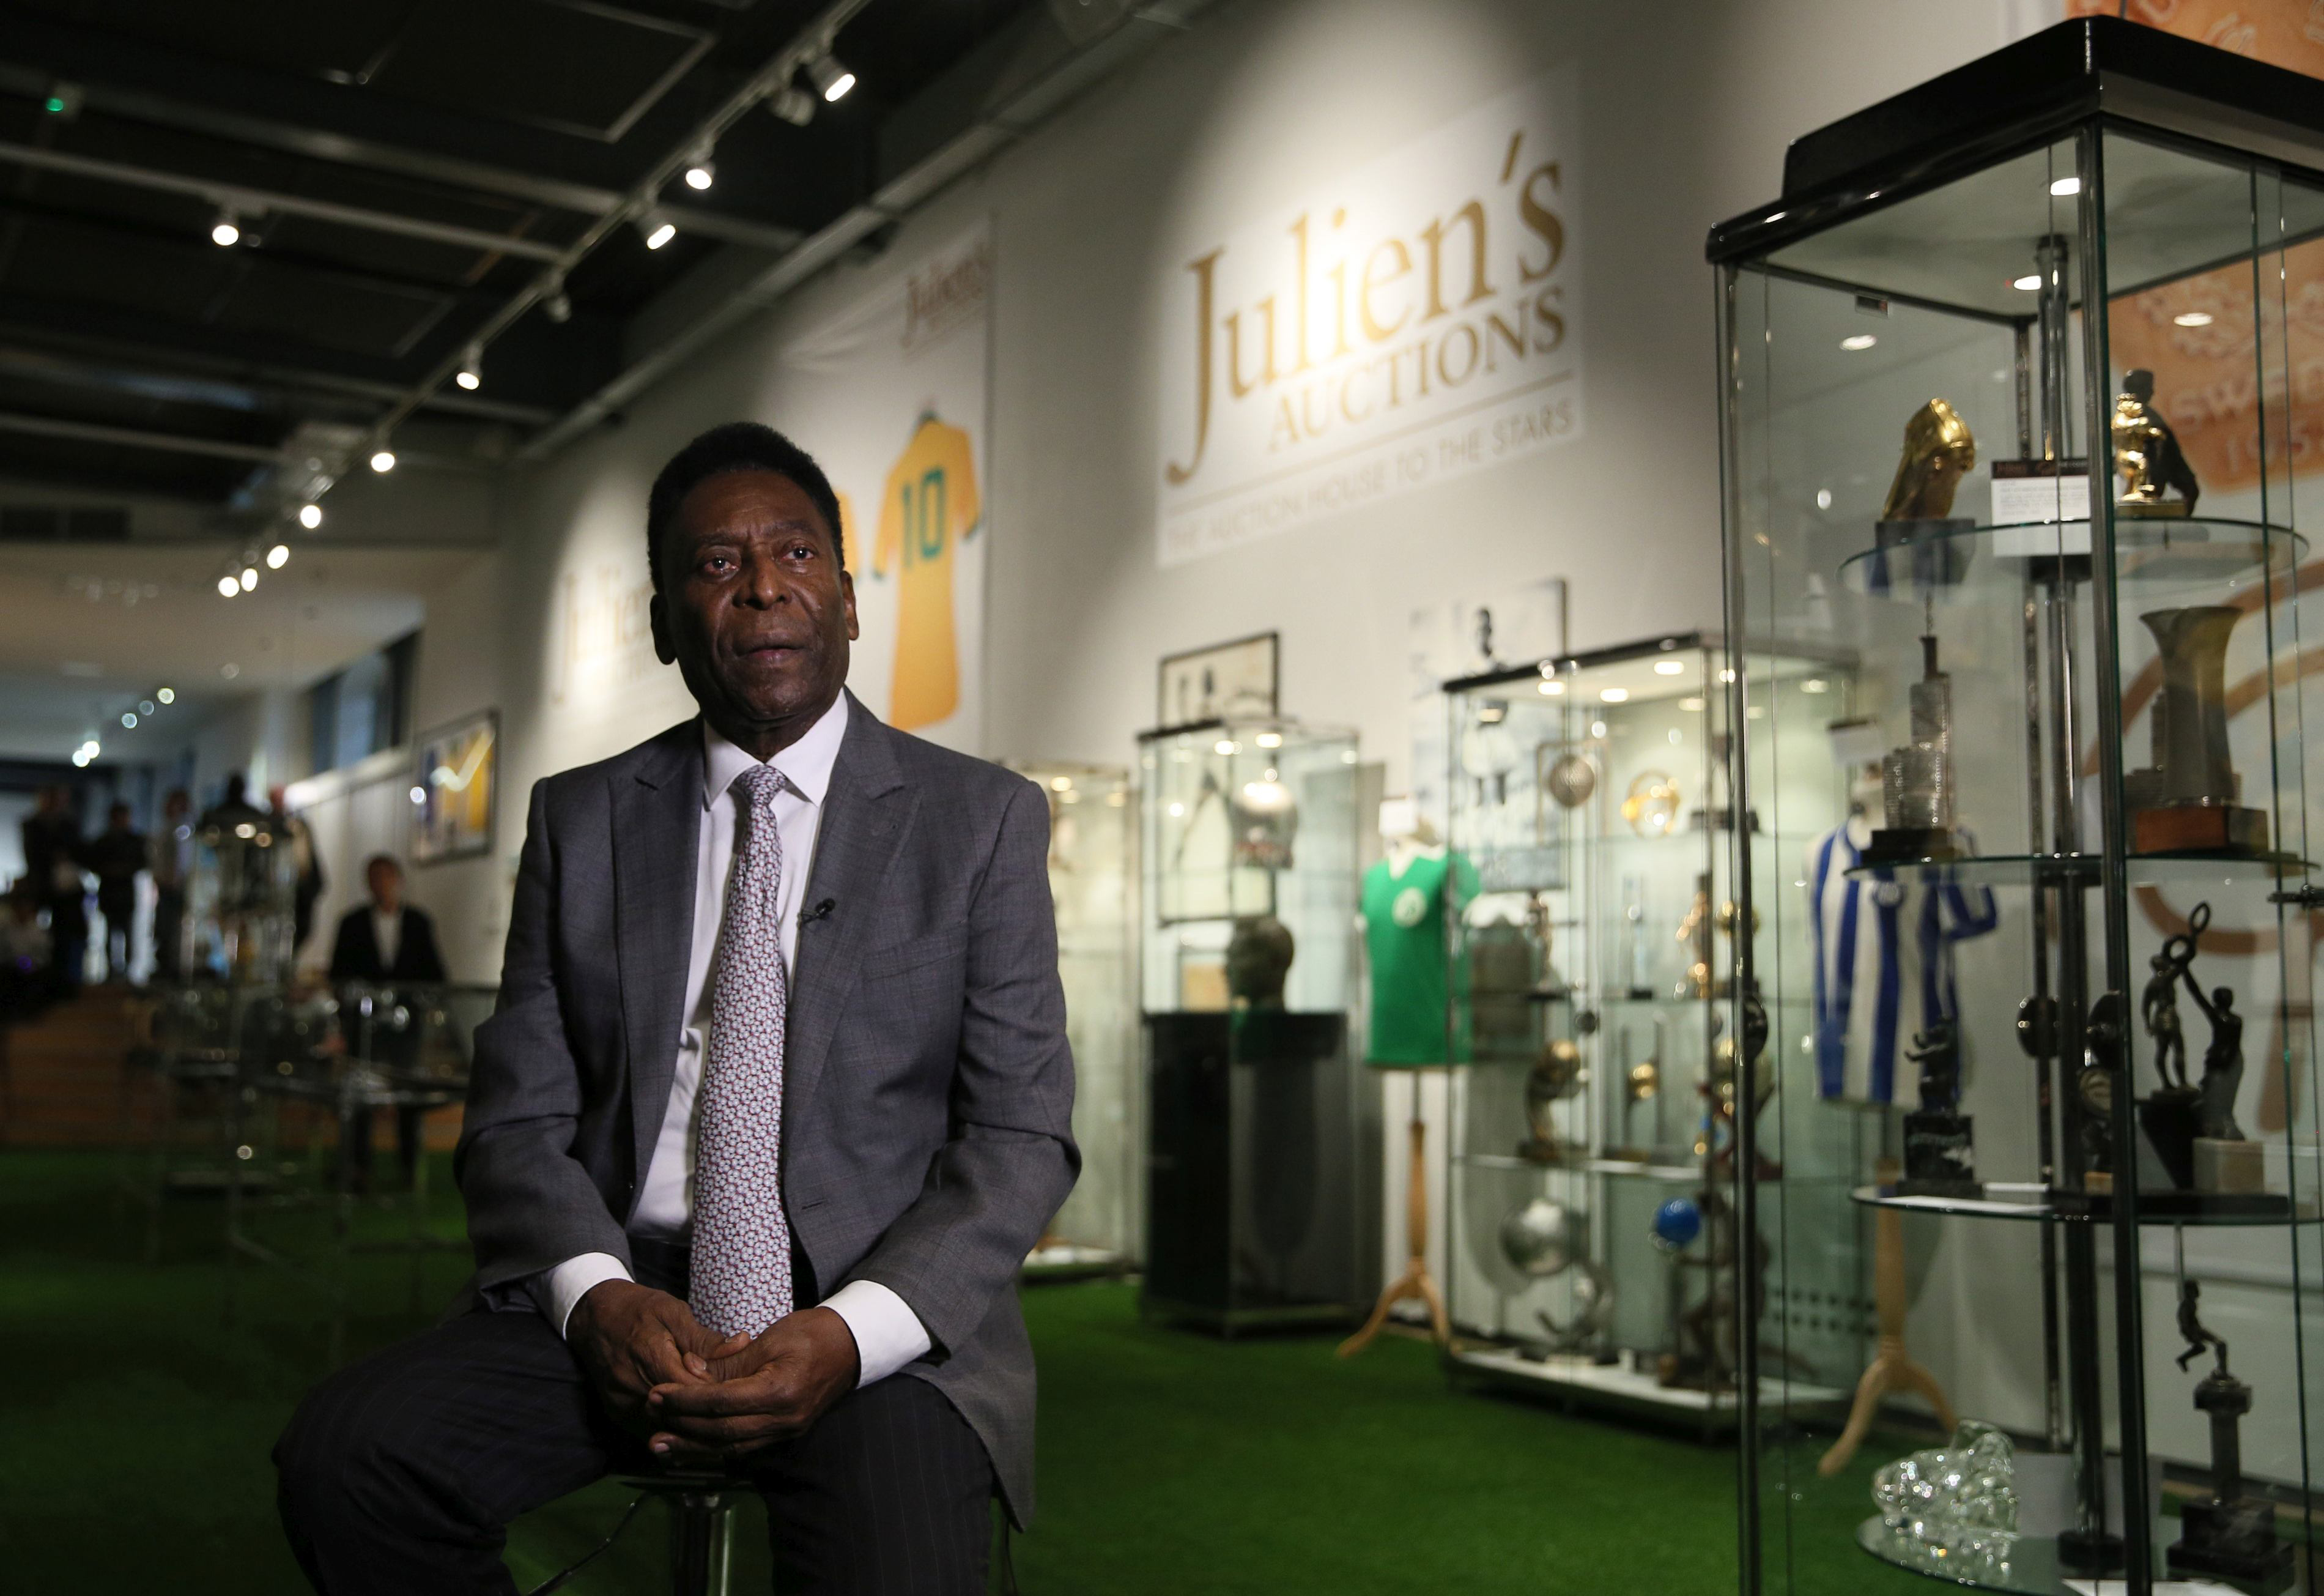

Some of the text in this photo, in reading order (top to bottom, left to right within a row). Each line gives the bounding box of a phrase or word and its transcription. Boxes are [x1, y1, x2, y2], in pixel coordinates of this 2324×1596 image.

[1165, 129, 1566, 486] Julien's
[1268, 284, 1566, 454] AUCTIONS
[1396, 448, 1428, 483] TO
[1438, 427, 1484, 467] THE
[1491, 396, 1575, 456] STARS
[901, 468, 946, 569] 10
